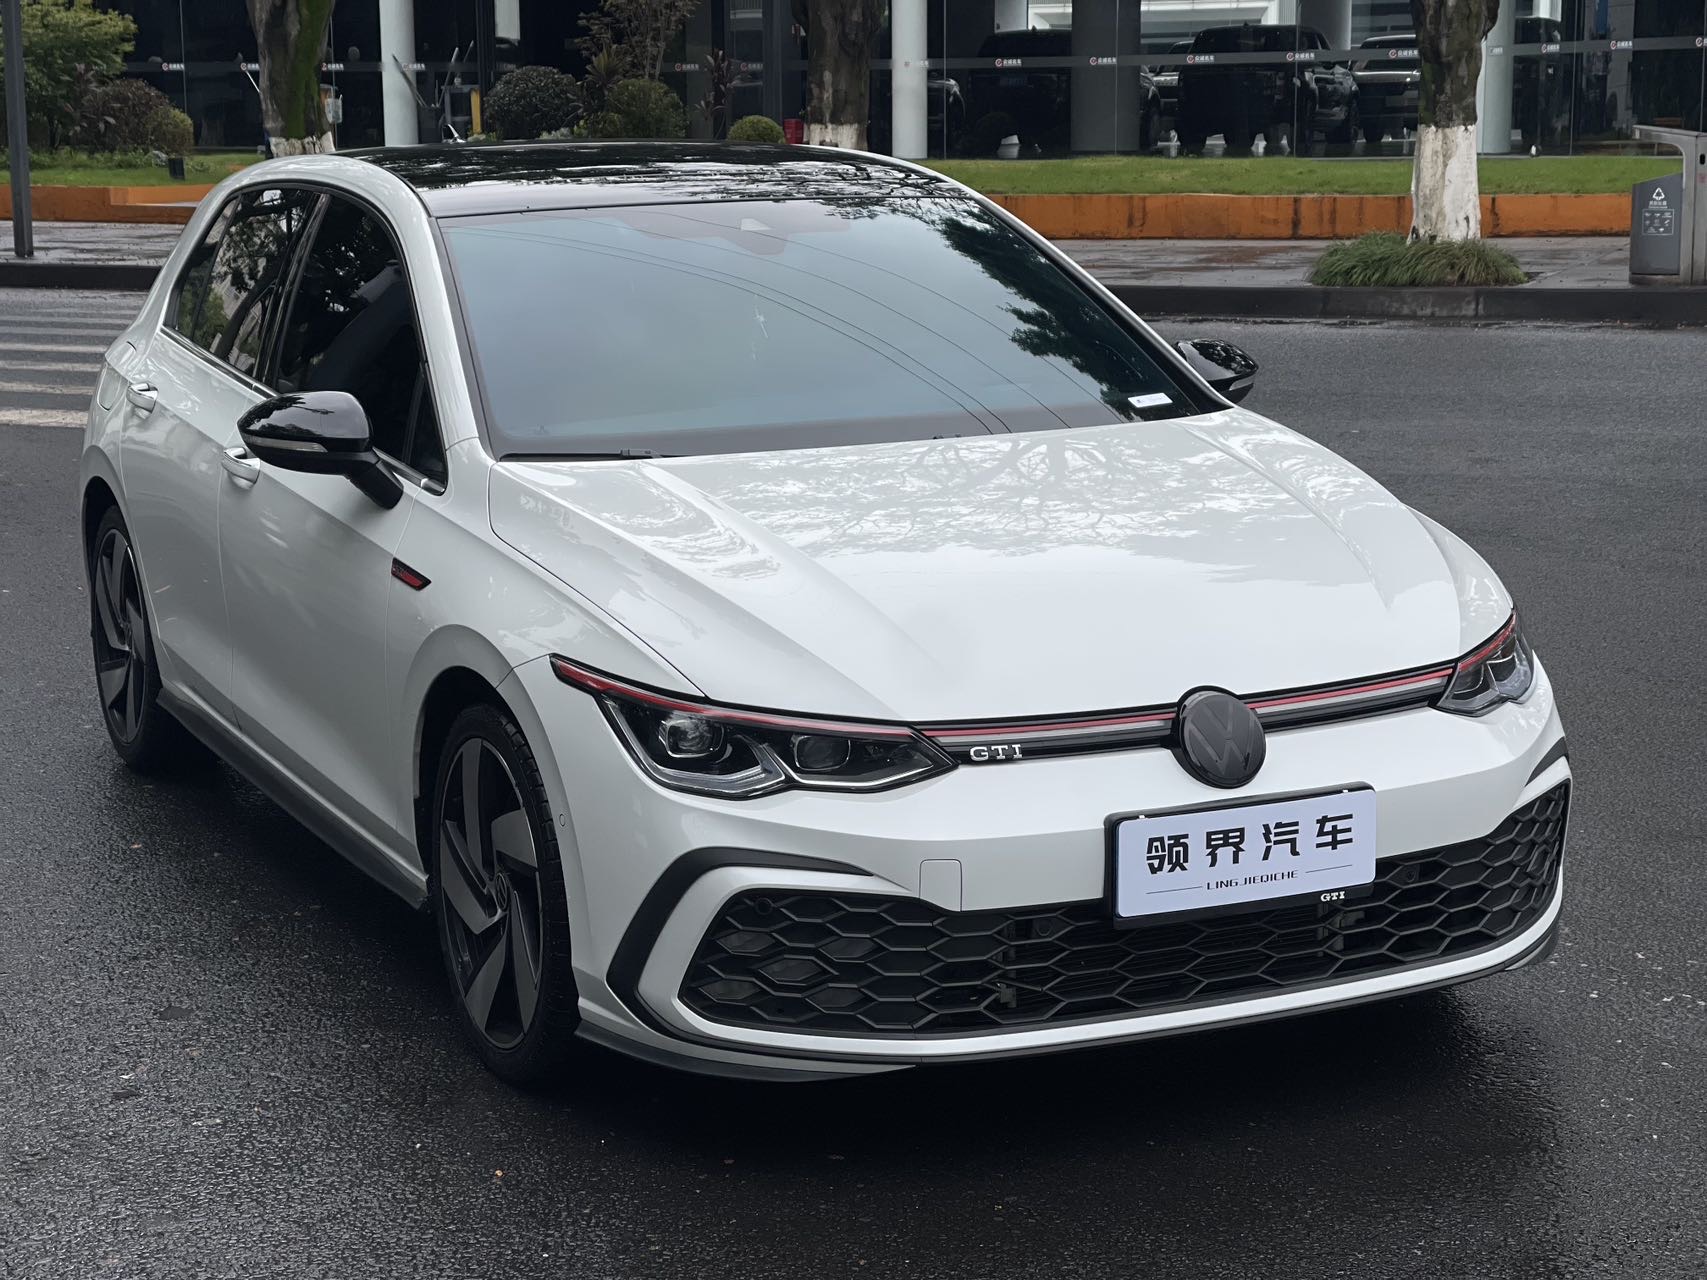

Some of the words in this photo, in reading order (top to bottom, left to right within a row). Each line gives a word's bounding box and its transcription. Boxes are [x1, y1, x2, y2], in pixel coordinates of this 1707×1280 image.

[970, 744, 1023, 761] GTI
[1146, 813, 1353, 875] 领界汽车
[1320, 890, 1346, 902] GTI
